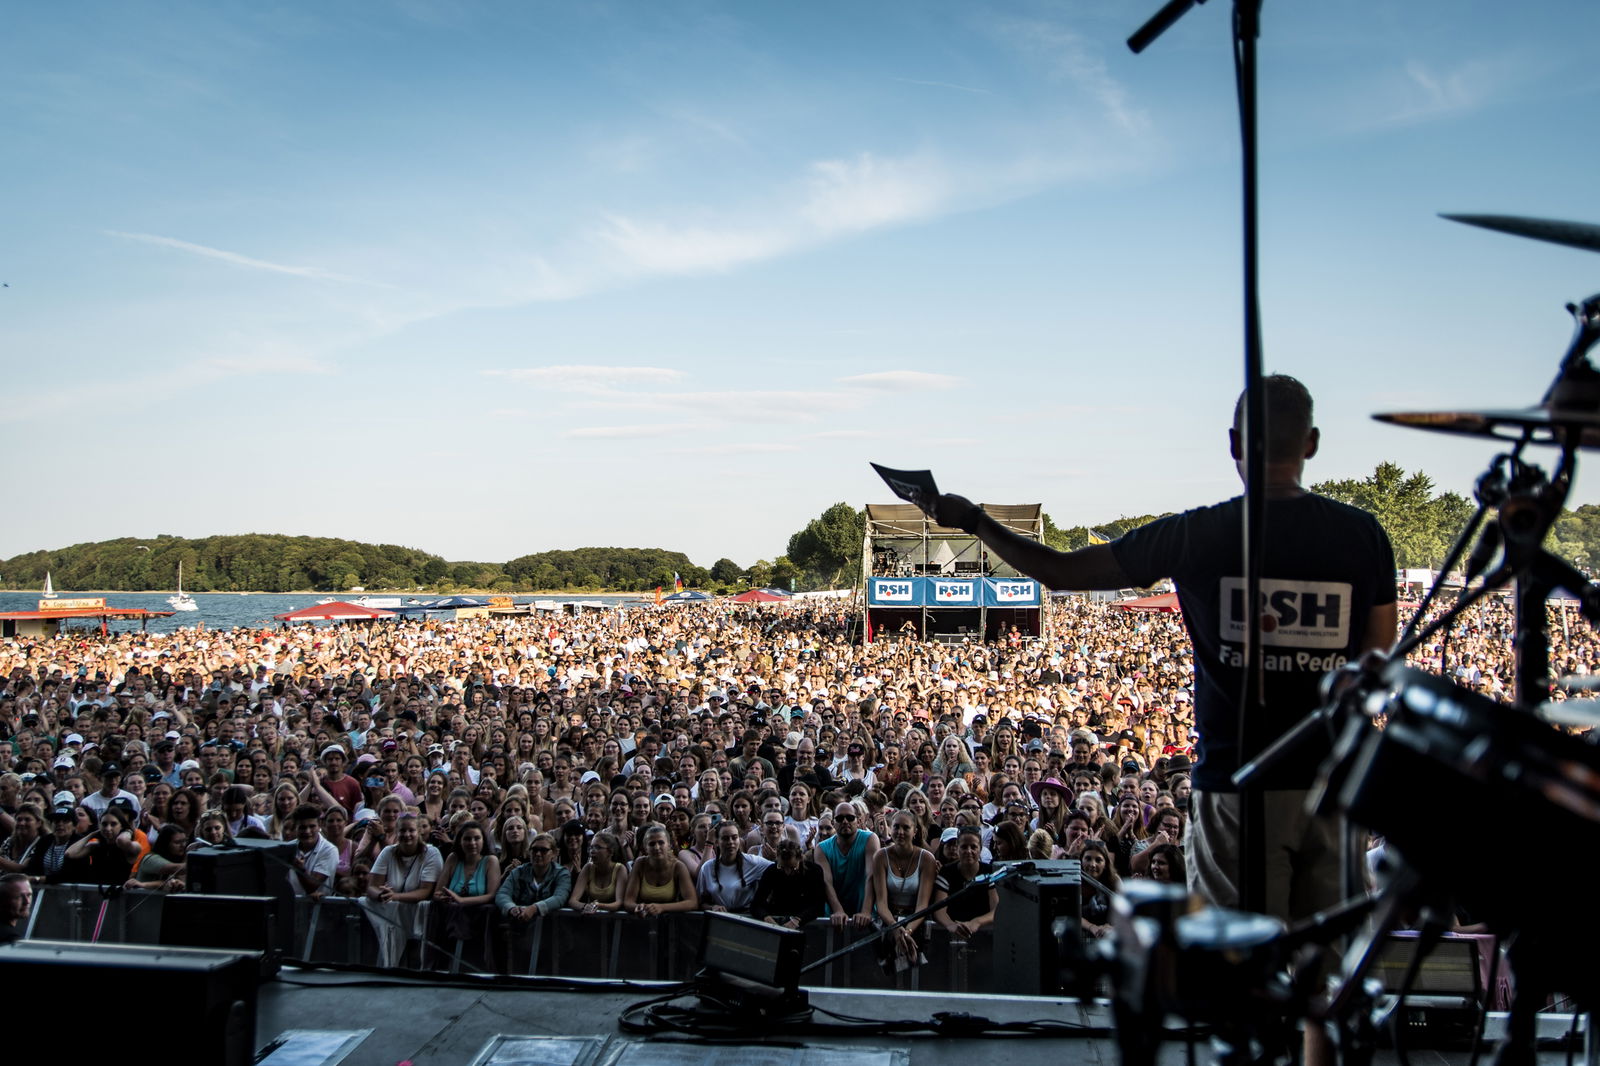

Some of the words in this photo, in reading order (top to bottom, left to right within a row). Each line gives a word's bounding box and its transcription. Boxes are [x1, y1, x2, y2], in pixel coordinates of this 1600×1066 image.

[878, 584, 909, 595] RSH
[938, 585, 970, 596] RSH
[1000, 585, 1031, 596] RSH
[1219, 645, 1293, 672] Faian
